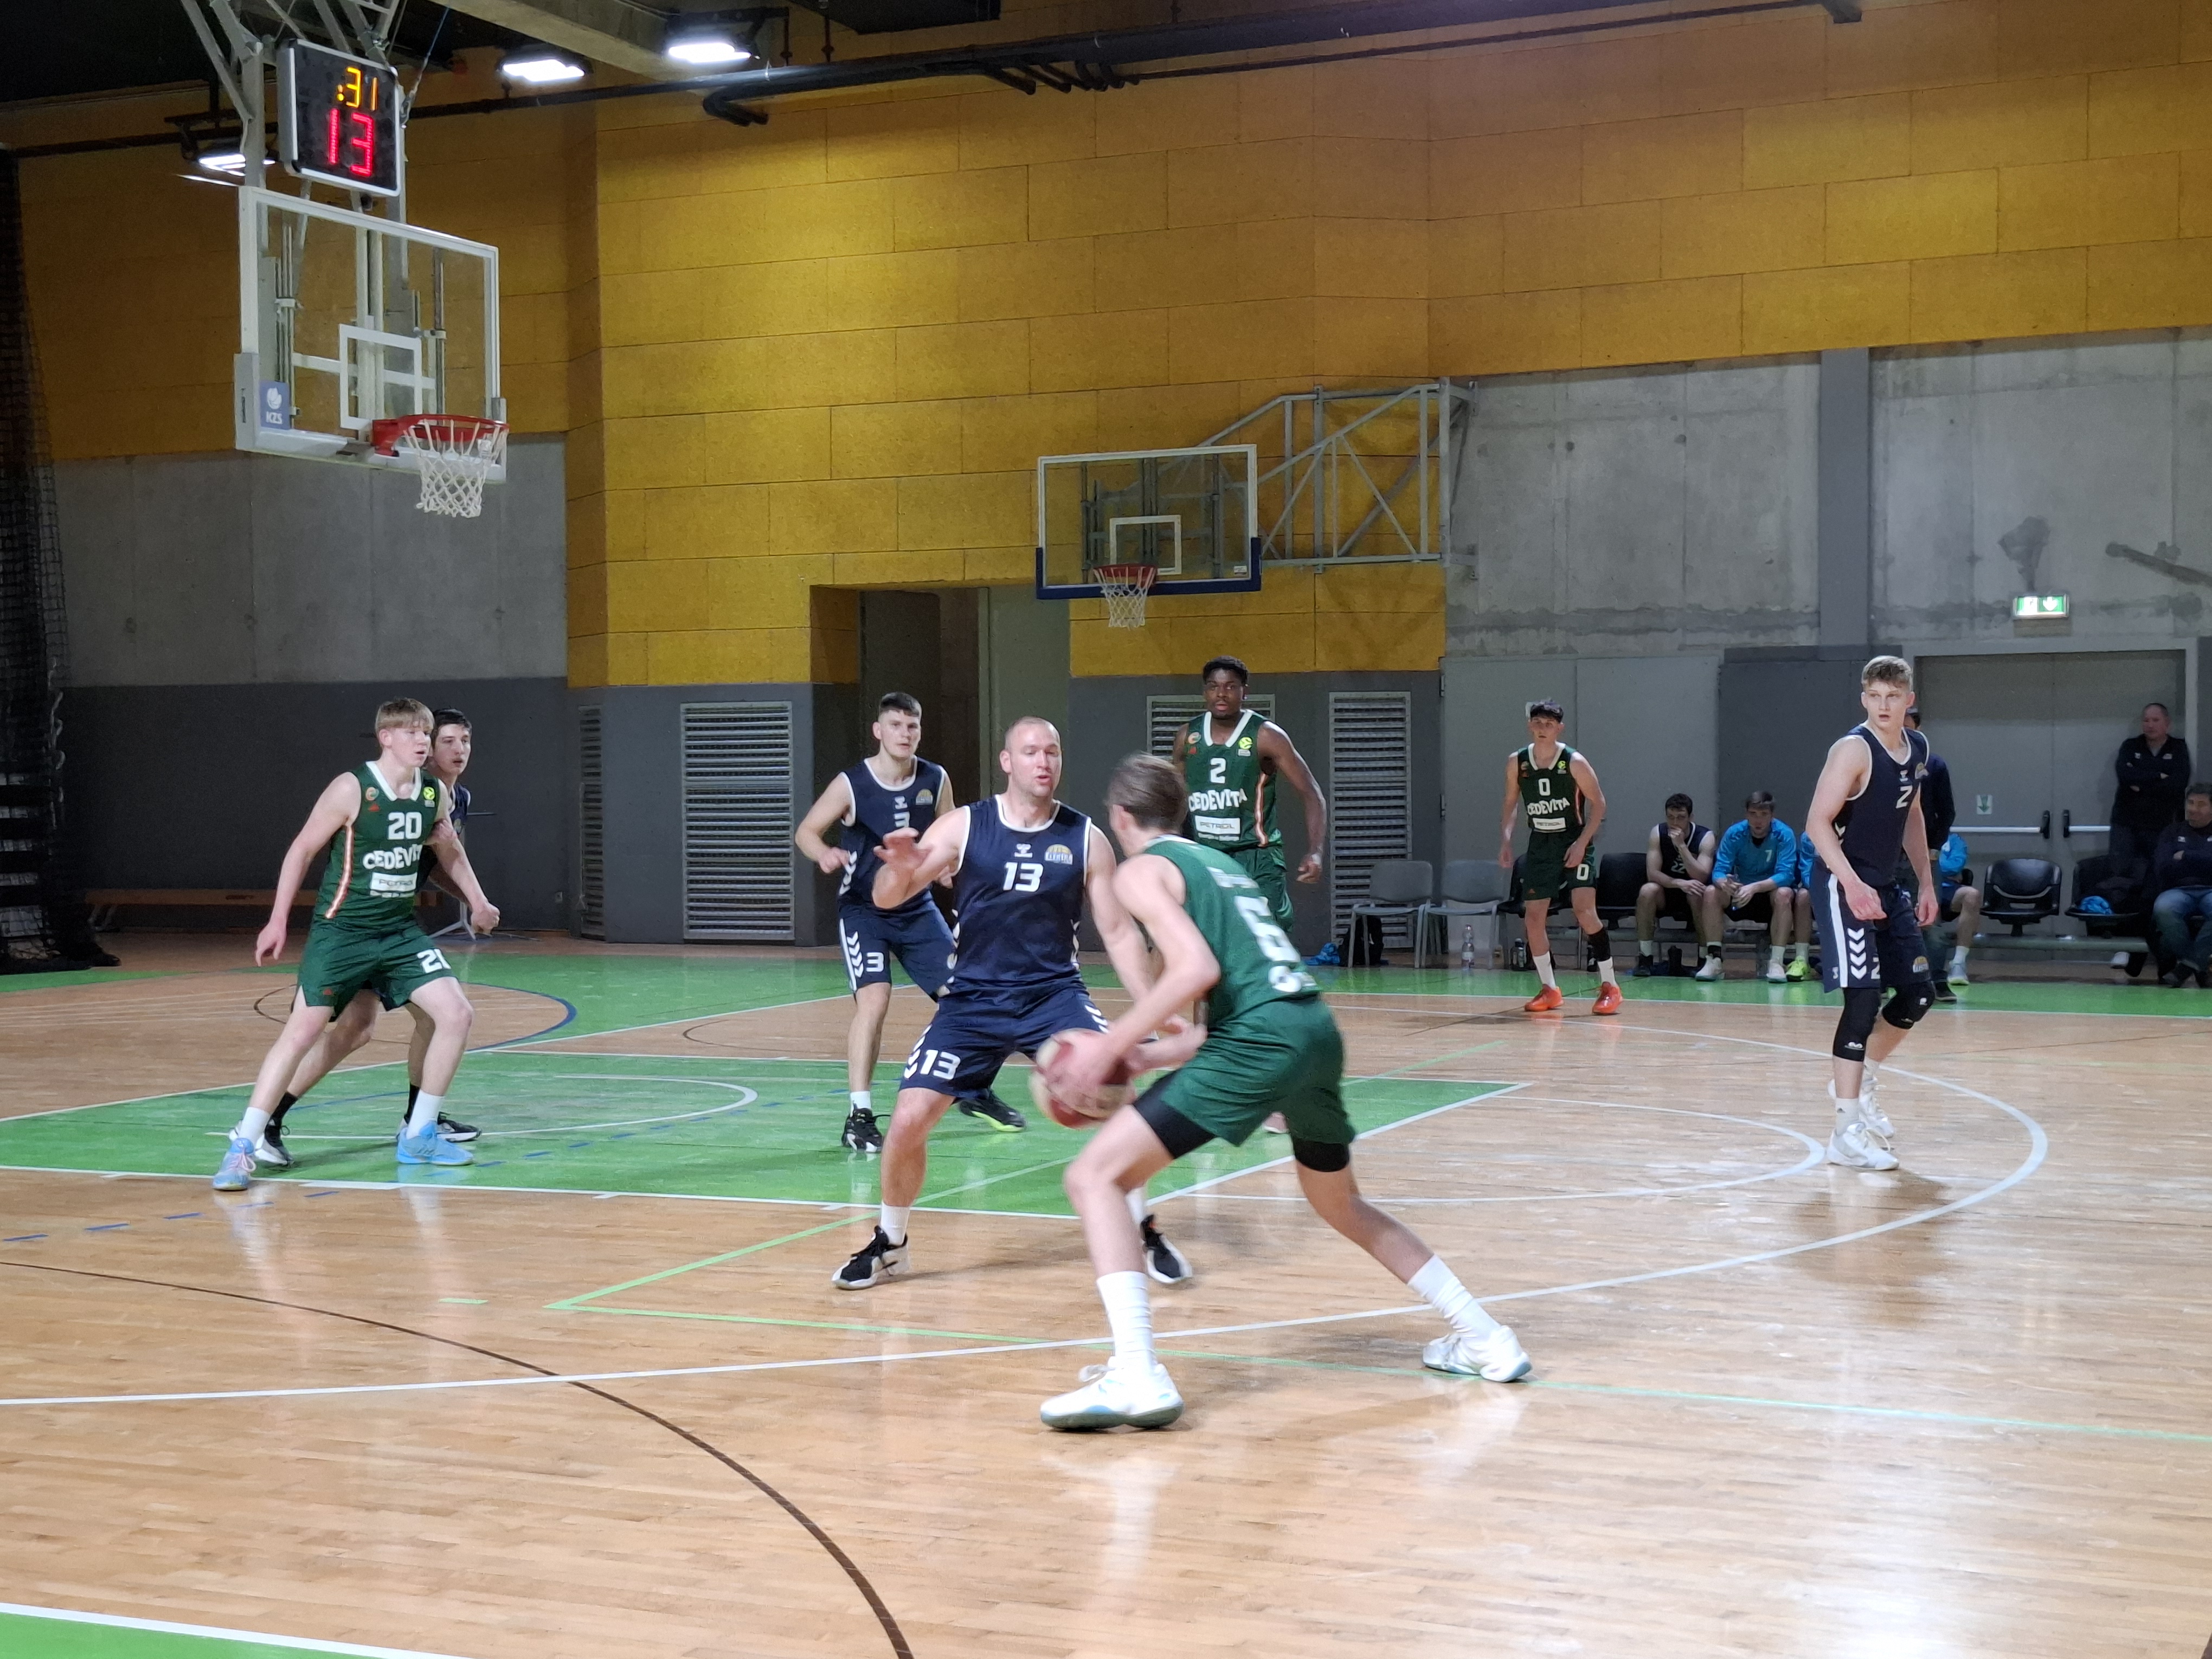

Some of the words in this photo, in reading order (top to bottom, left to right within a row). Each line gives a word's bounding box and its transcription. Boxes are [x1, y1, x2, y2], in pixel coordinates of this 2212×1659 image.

[329, 108, 374, 177] 13
[1210, 757, 1226, 784] 2
[1188, 788, 1248, 812] CEDEVITA
[1527, 797, 1571, 815] CEDEVITA
[1895, 785, 1913, 809] 2
[388, 812, 422, 840] 20
[363, 844, 423, 870] CEDEVIT
[1003, 861, 1044, 892] 13
[866, 952, 884, 972] 3
[920, 1049, 961, 1080] 13
